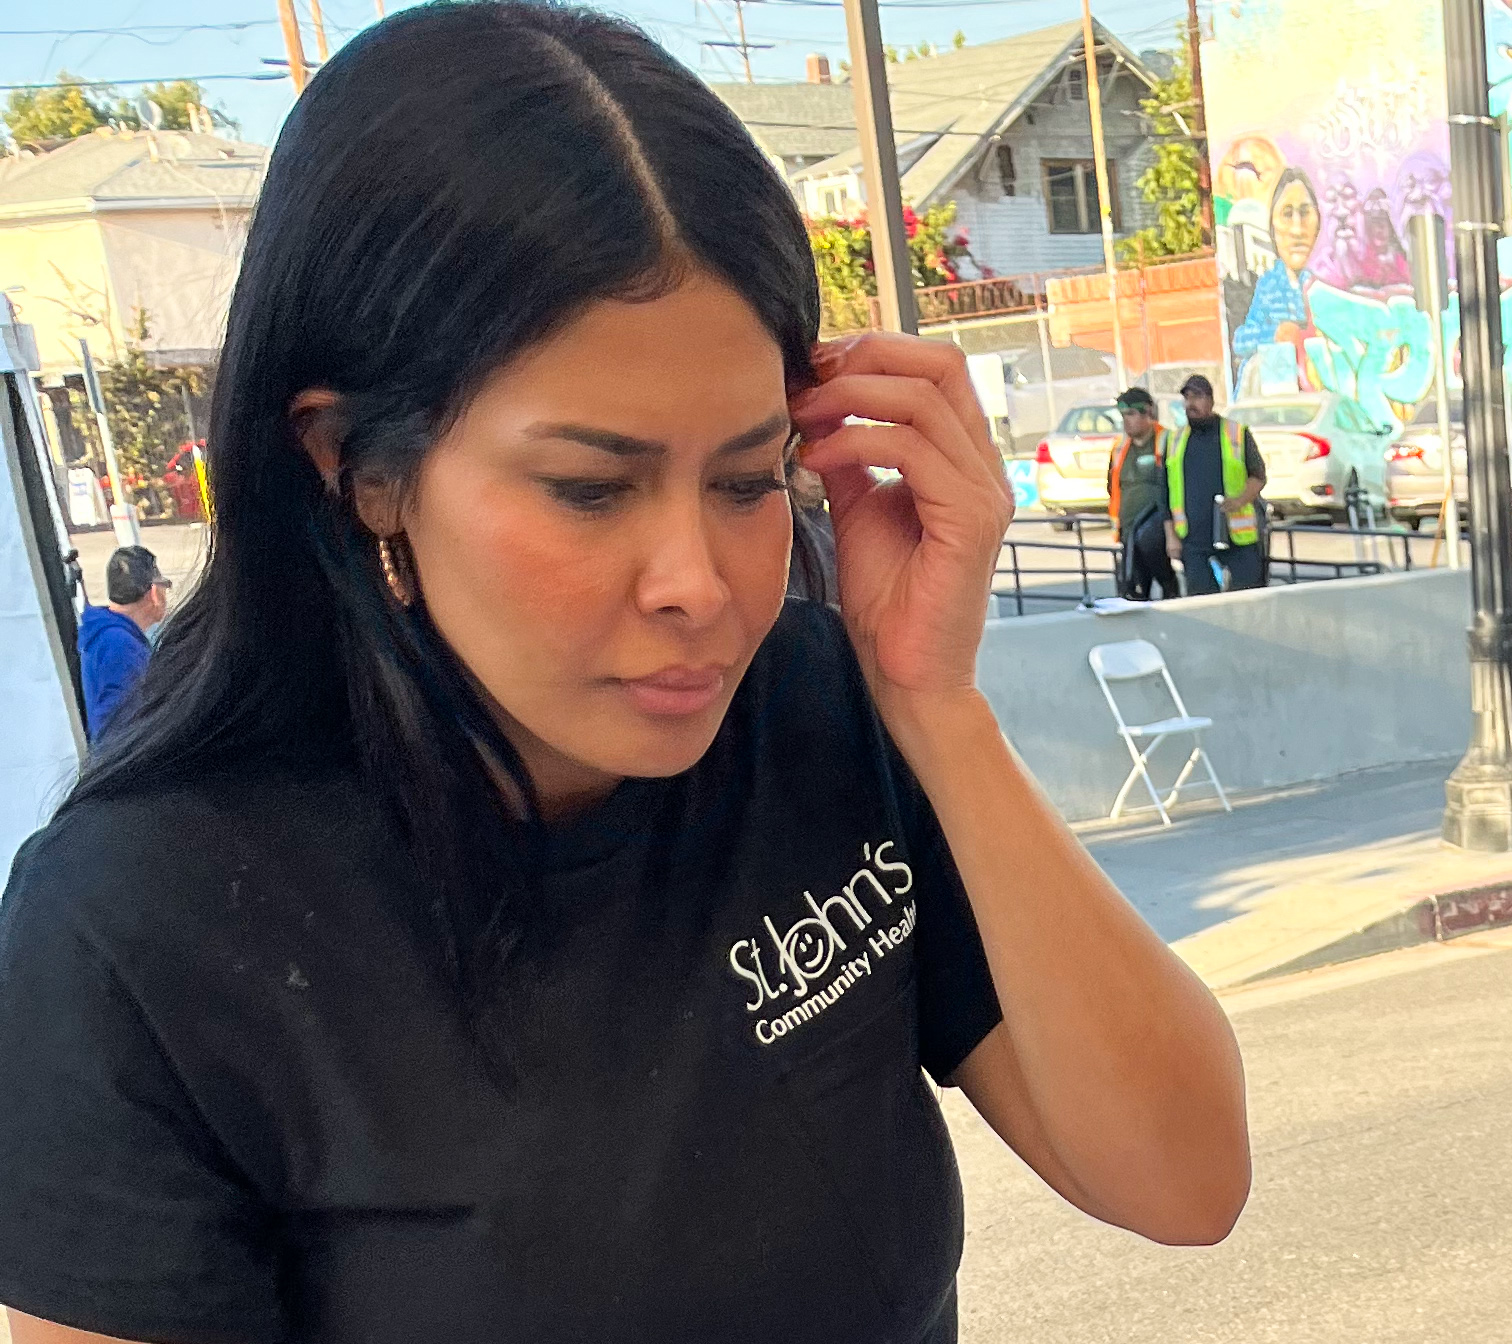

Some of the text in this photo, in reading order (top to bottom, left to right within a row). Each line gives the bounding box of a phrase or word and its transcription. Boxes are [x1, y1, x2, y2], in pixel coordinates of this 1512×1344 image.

[729, 840, 913, 1011] St. John's
[755, 951, 872, 1045] Community
